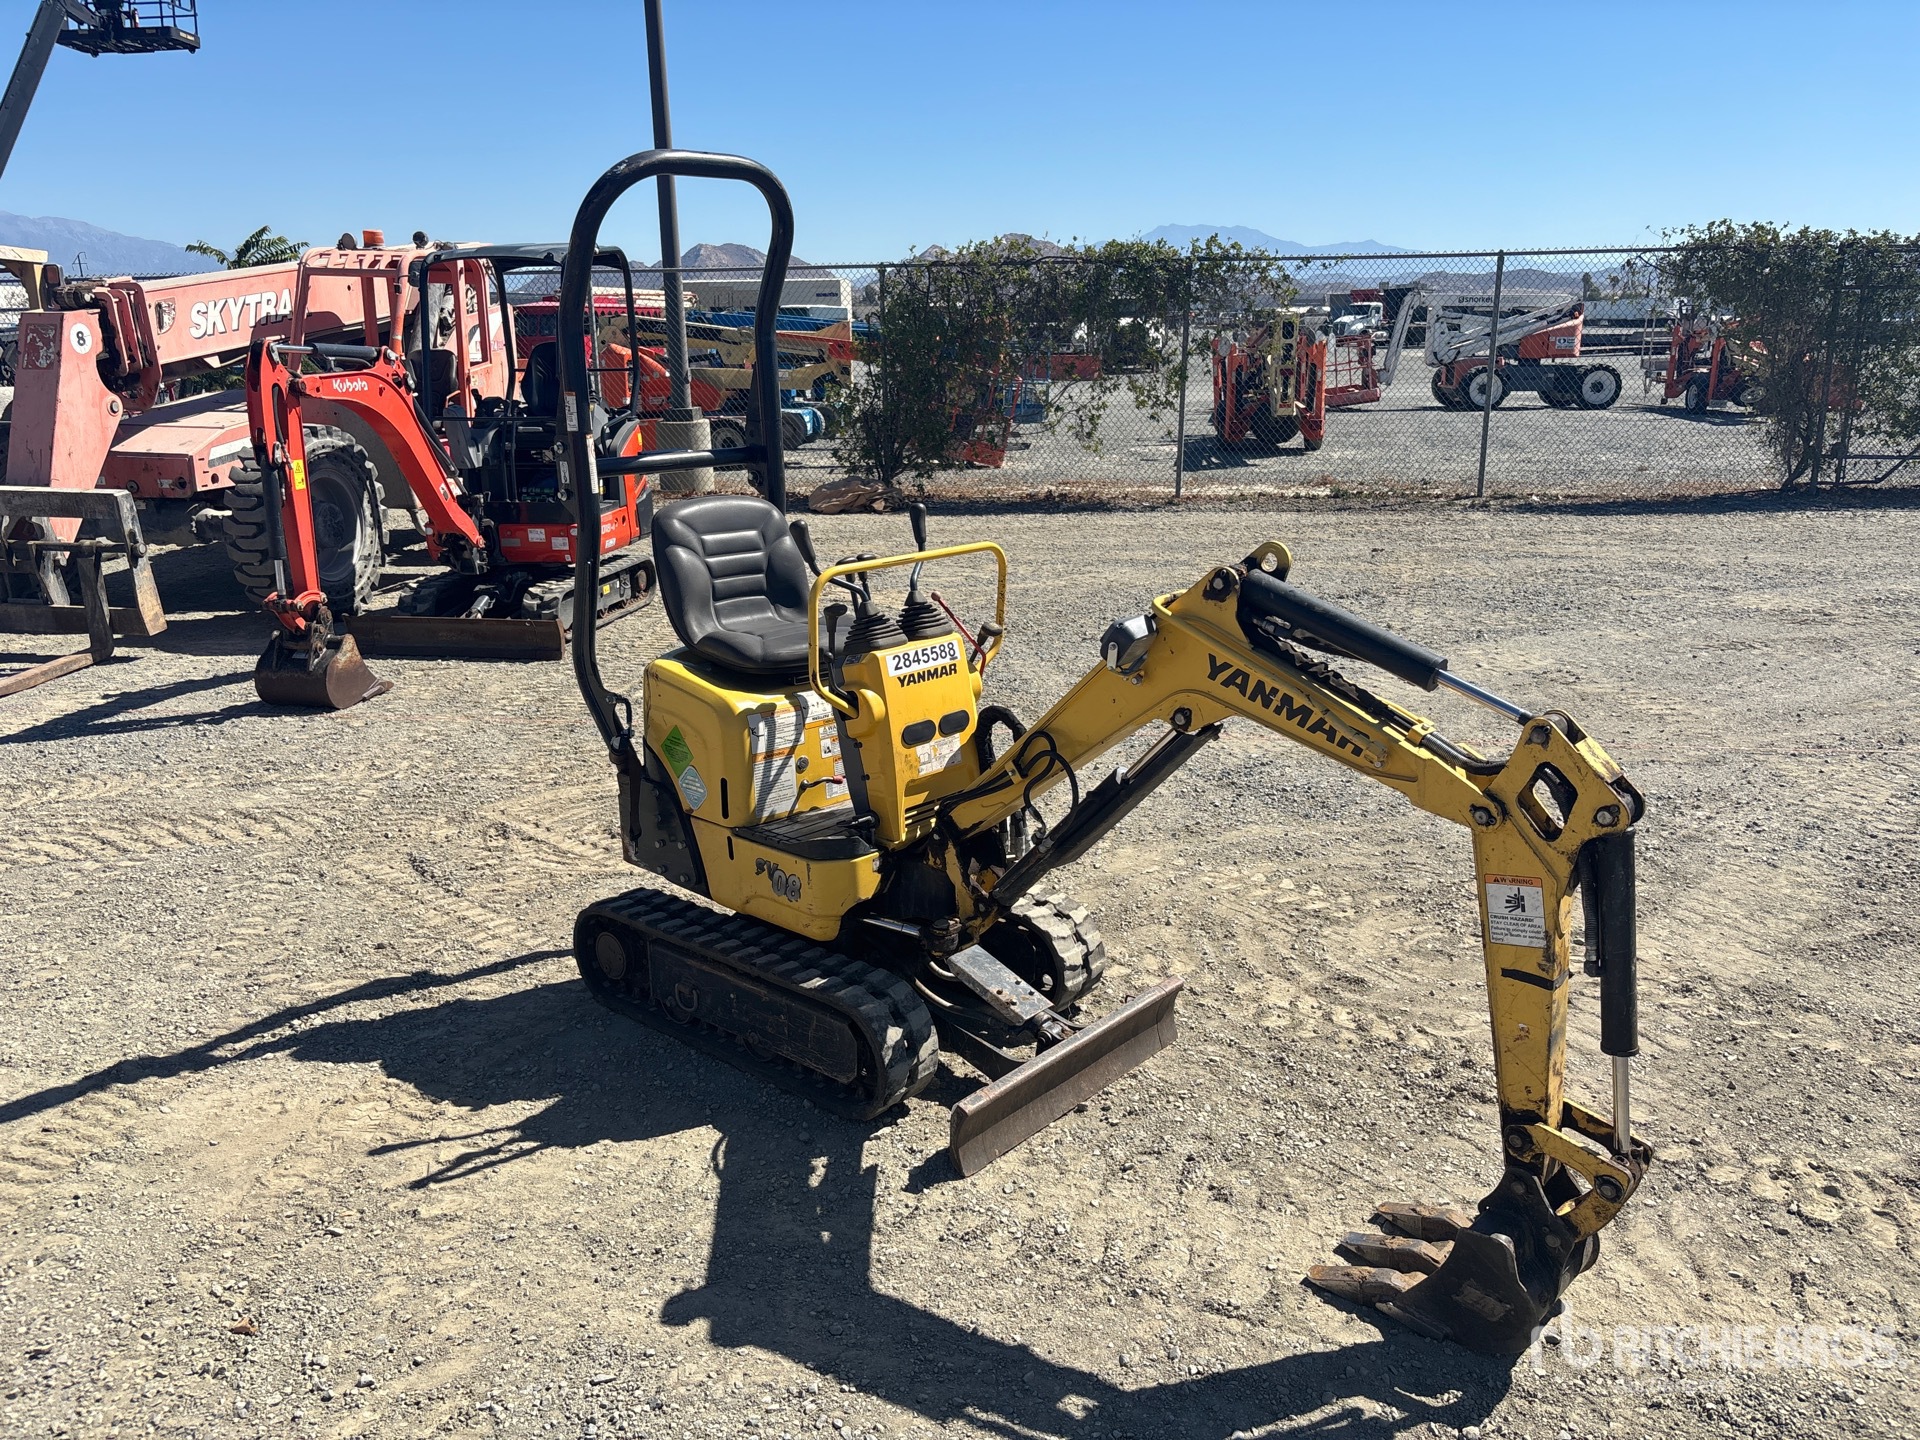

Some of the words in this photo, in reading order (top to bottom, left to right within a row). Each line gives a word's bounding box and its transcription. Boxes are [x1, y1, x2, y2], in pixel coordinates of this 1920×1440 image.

[189, 287, 312, 340] SKYTRA
[75, 330, 87, 347] 8
[332, 378, 369, 393] Kubota
[892, 642, 956, 671] 2845588
[896, 663, 958, 688] YANMAR
